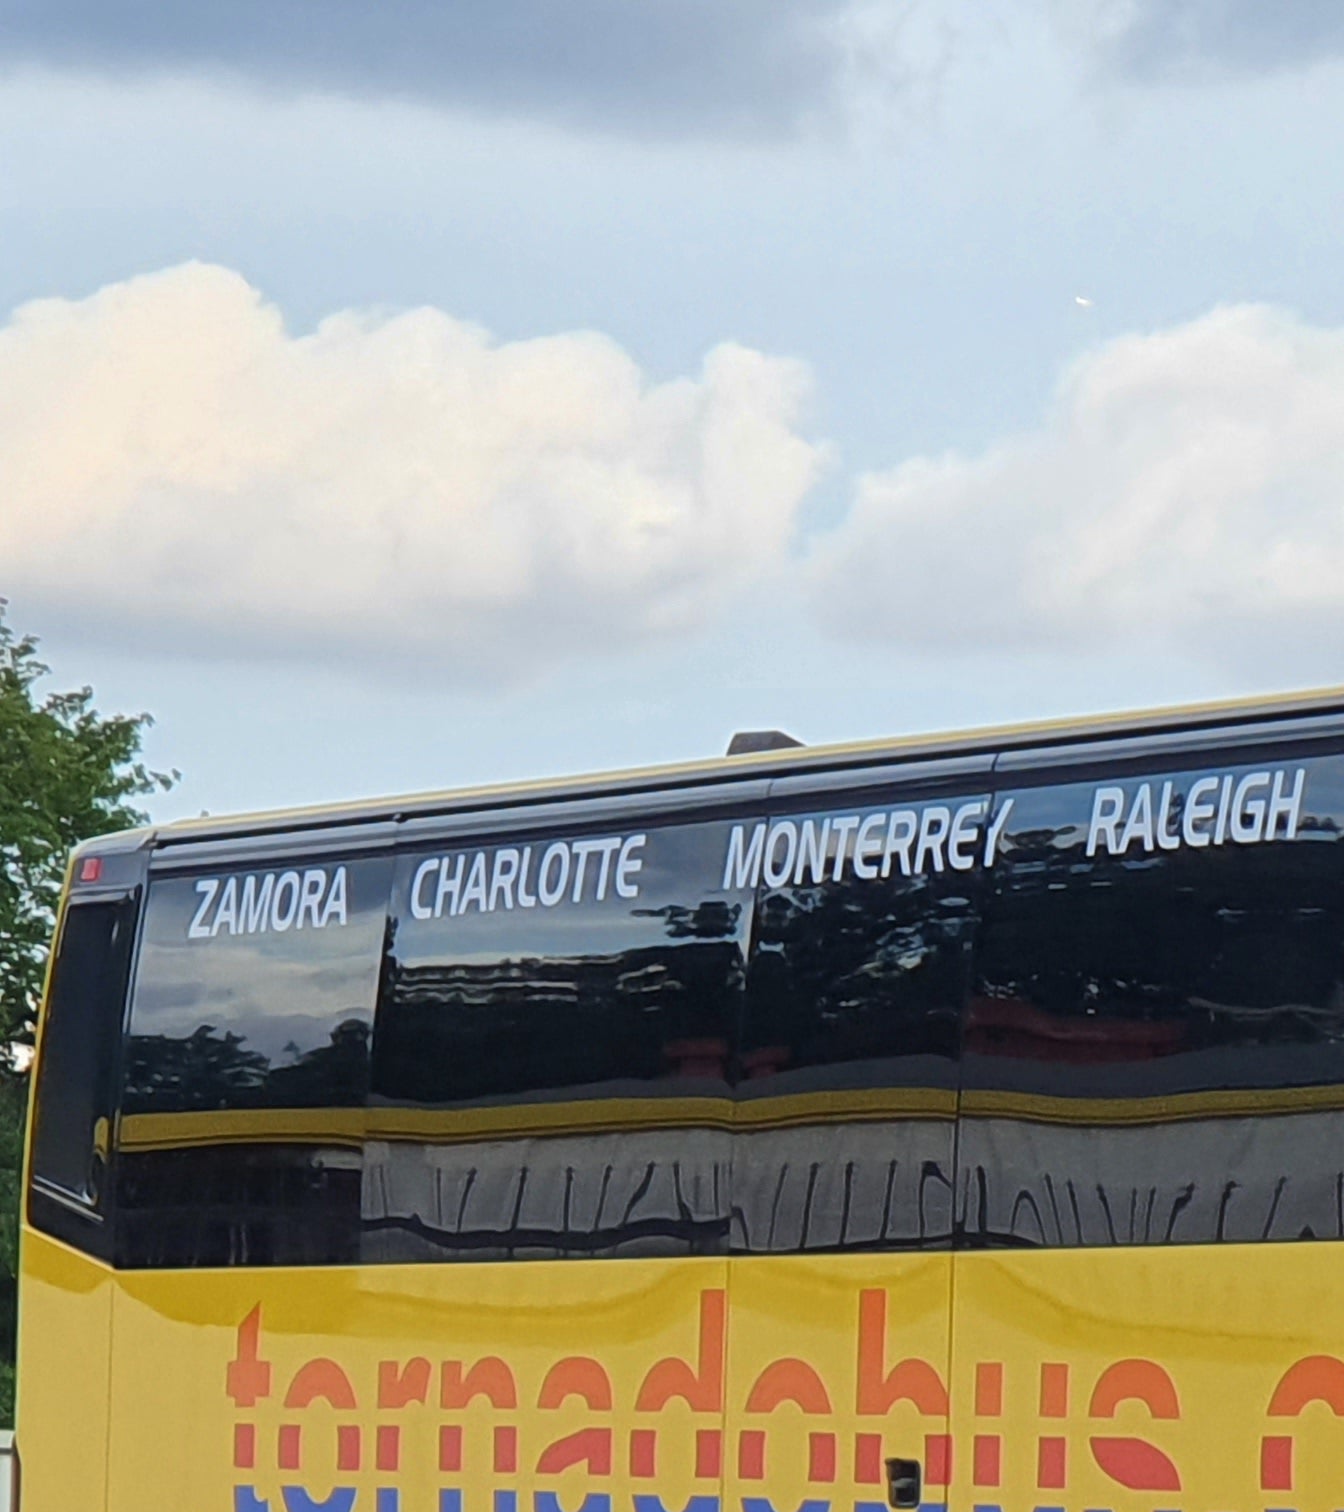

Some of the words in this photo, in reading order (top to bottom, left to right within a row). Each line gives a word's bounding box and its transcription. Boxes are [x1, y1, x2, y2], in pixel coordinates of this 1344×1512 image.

[723, 798, 1014, 890] MONTERREY
[1085, 768, 1307, 857] RALEIGH
[187, 866, 349, 940] ZAMORA
[410, 834, 647, 921] CHARLOTTE
